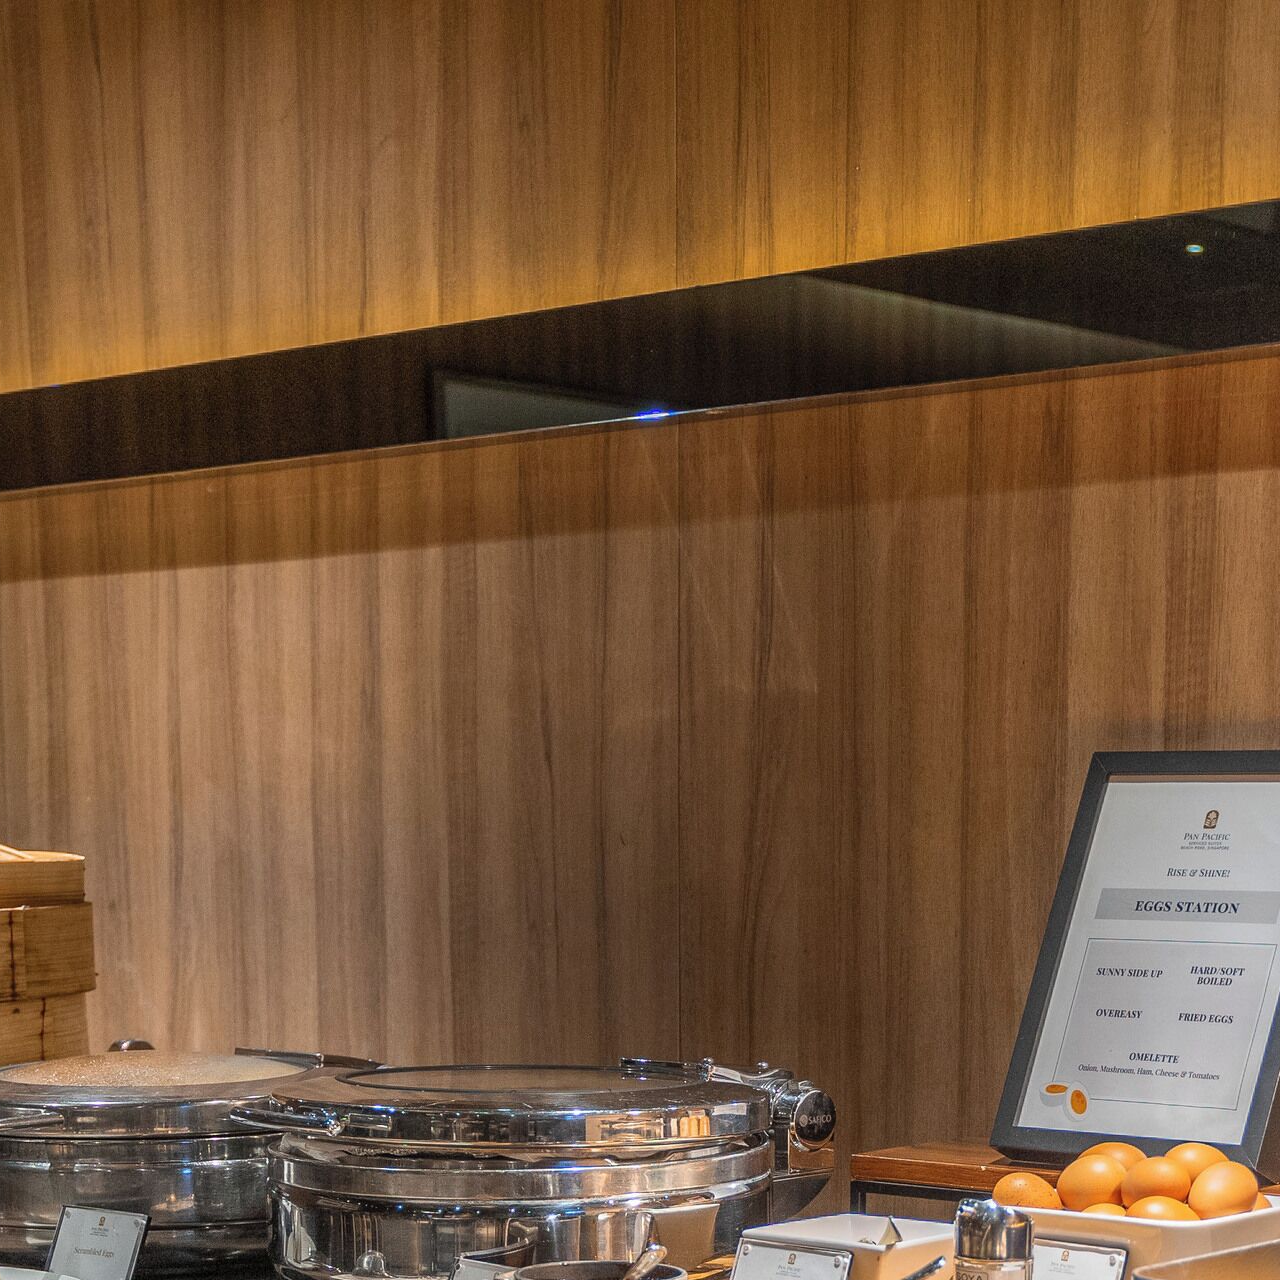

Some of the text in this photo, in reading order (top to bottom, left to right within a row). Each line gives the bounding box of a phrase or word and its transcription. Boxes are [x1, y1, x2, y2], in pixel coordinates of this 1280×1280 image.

[1183, 832, 1231, 841] PAN PACIFIC
[1166, 867, 1231, 878] RISE & SHINE!
[1135, 900, 1240, 914] EGGS STATION
[1096, 967, 1163, 978] SUNNY SIDE UP
[1190, 966, 1246, 976] HARD/SOFT
[1196, 976, 1233, 986] BOILED
[1095, 1008, 1143, 1019] OVEREASY
[1178, 1012, 1234, 1024] FRIED EGGS
[1129, 1052, 1180, 1064] OMELETTE
[1078, 1063, 1099, 1073] Onion,
[1100, 1065, 1136, 1075] Mushroom,
[1136, 1067, 1154, 1076] Ham,
[1155, 1069, 1179, 1078] Cheese
[1188, 1071, 1220, 1081] Tomatoes
[73, 1247, 103, 1257] Scrambled
